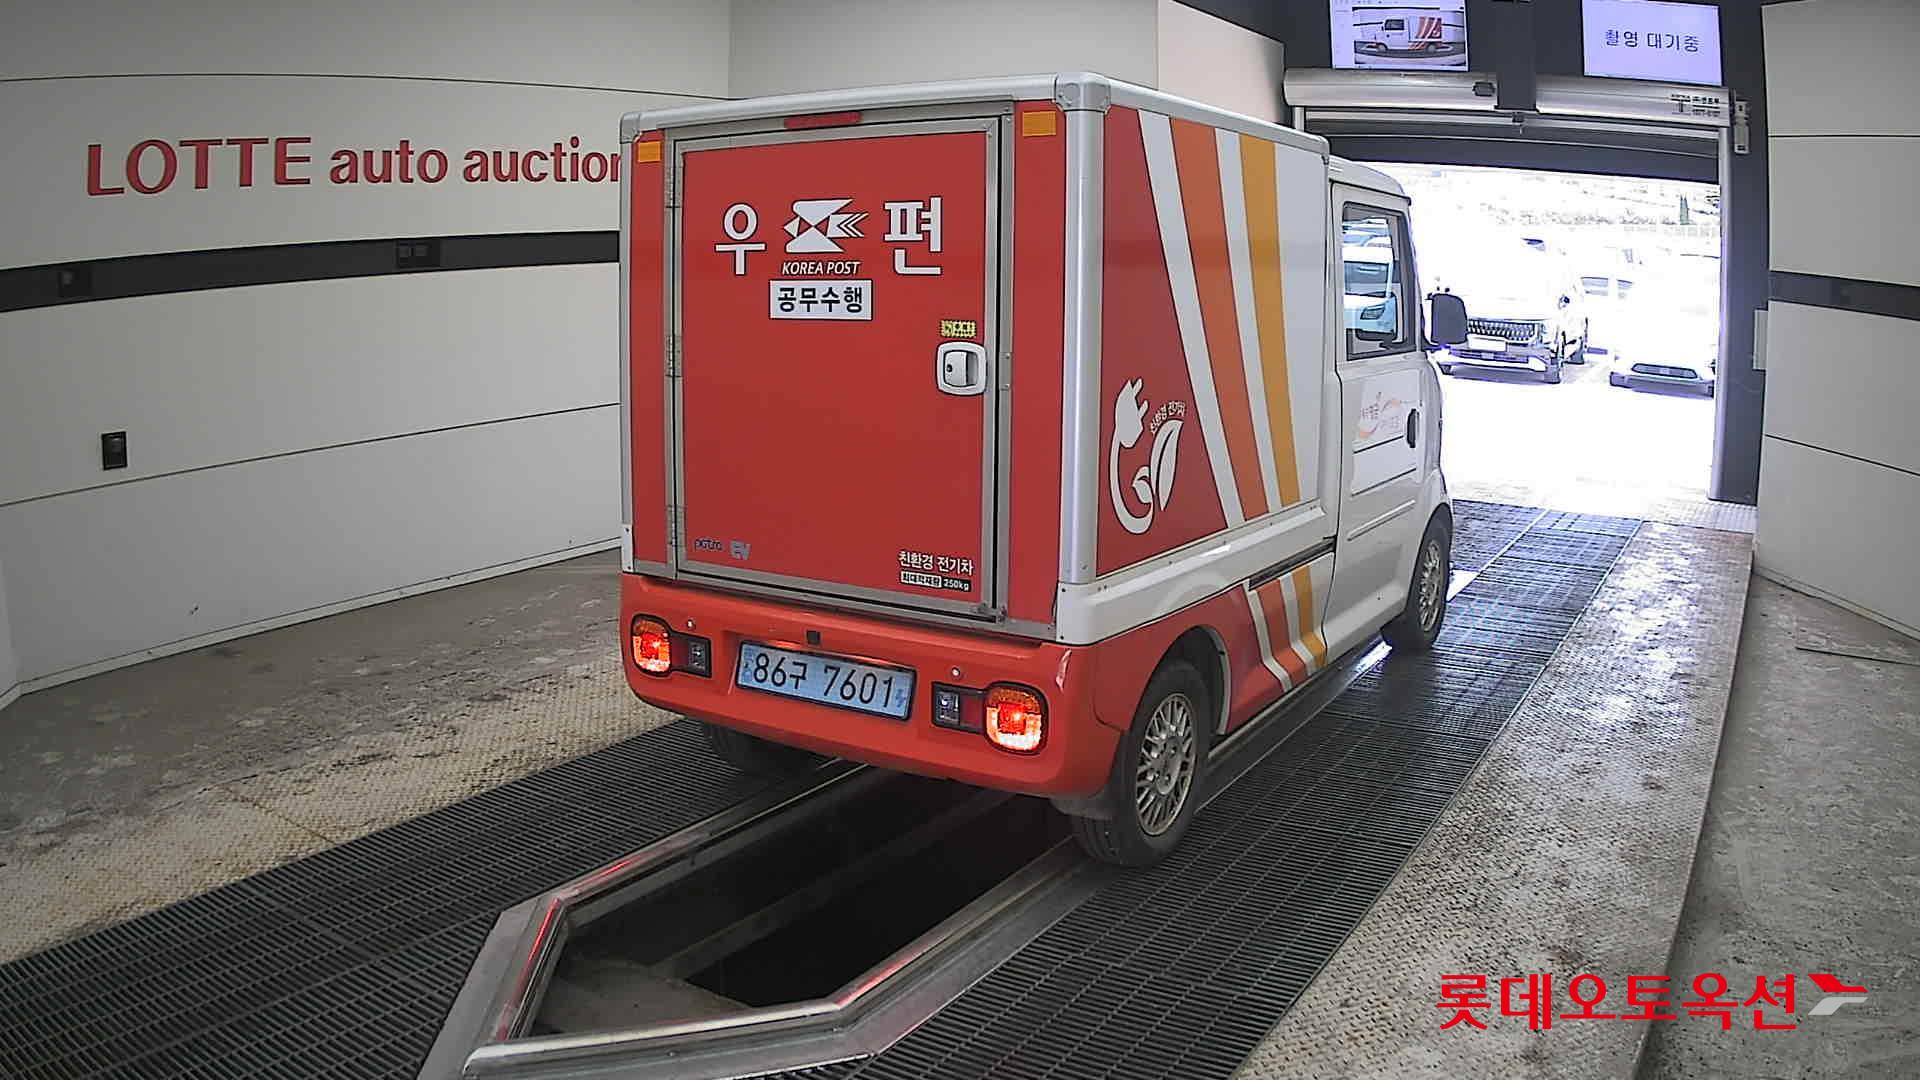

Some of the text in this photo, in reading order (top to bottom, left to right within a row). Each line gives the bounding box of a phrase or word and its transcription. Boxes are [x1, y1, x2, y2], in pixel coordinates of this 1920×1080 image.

[1647, 32, 1699, 52] 대기중
[87, 136, 312, 196] LOTTE
[329, 139, 449, 184] auto
[715, 197, 942, 275] 우 편
[781, 260, 861, 275] KOREA POST
[778, 286, 863, 313] 공무수행
[898, 551, 974, 576] 친환경 전기차
[943, 579, 969, 591] 250kg
[753, 653, 894, 708] 86구 7601
